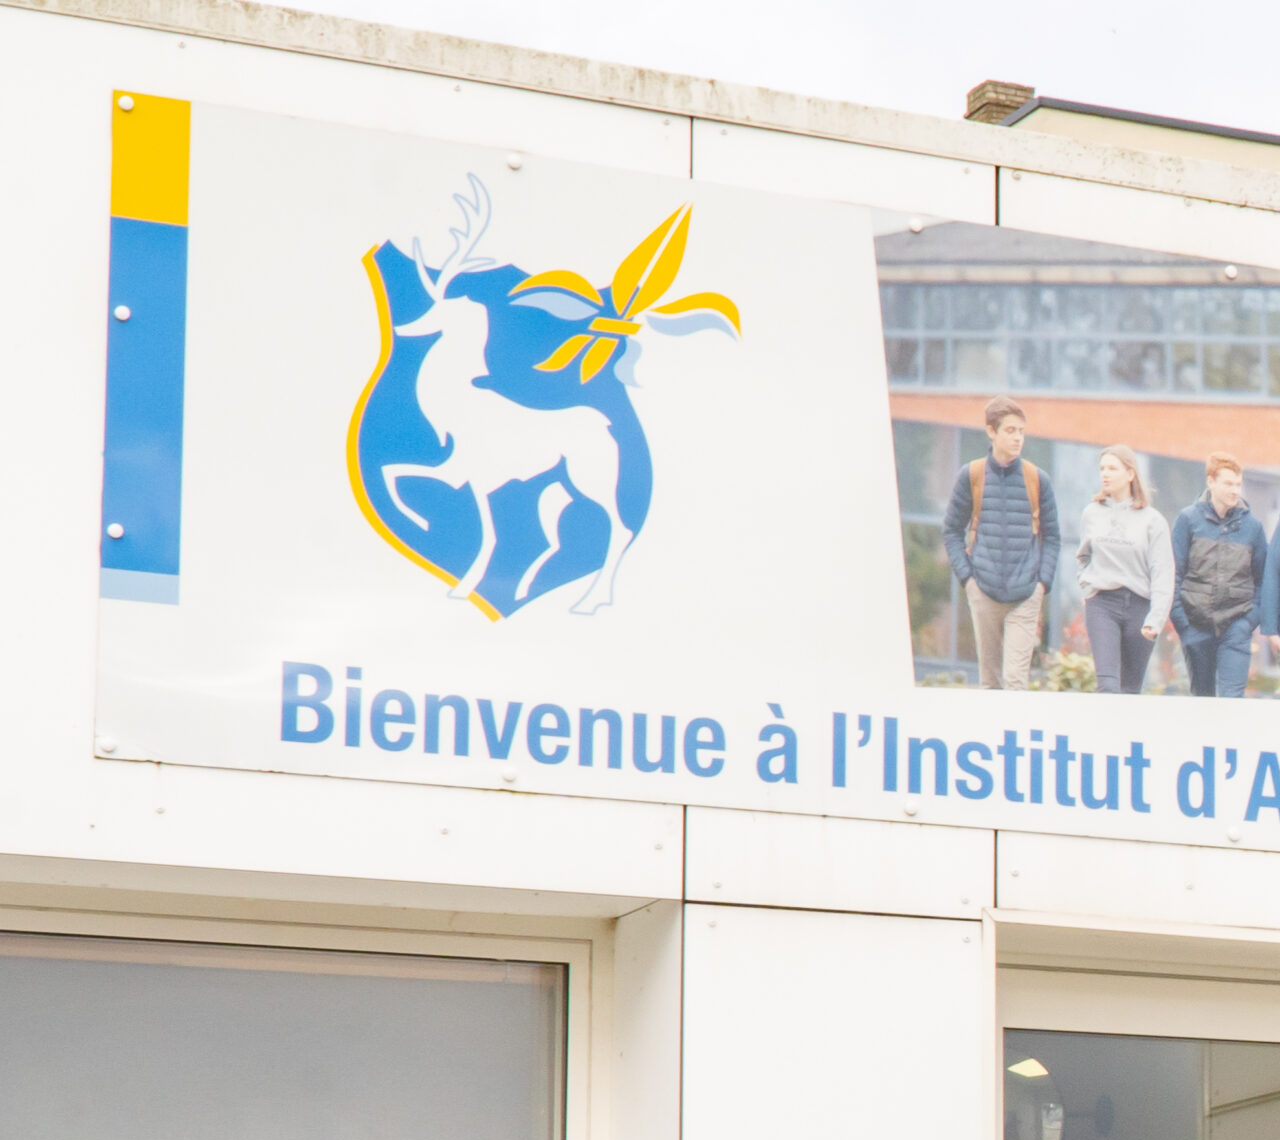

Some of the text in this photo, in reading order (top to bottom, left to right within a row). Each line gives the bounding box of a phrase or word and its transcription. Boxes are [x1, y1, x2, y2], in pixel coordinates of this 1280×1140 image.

[280, 660, 727, 778] Bienvenue
[756, 702, 799, 785] à
[831, 710, 1152, 813] l'Institut
